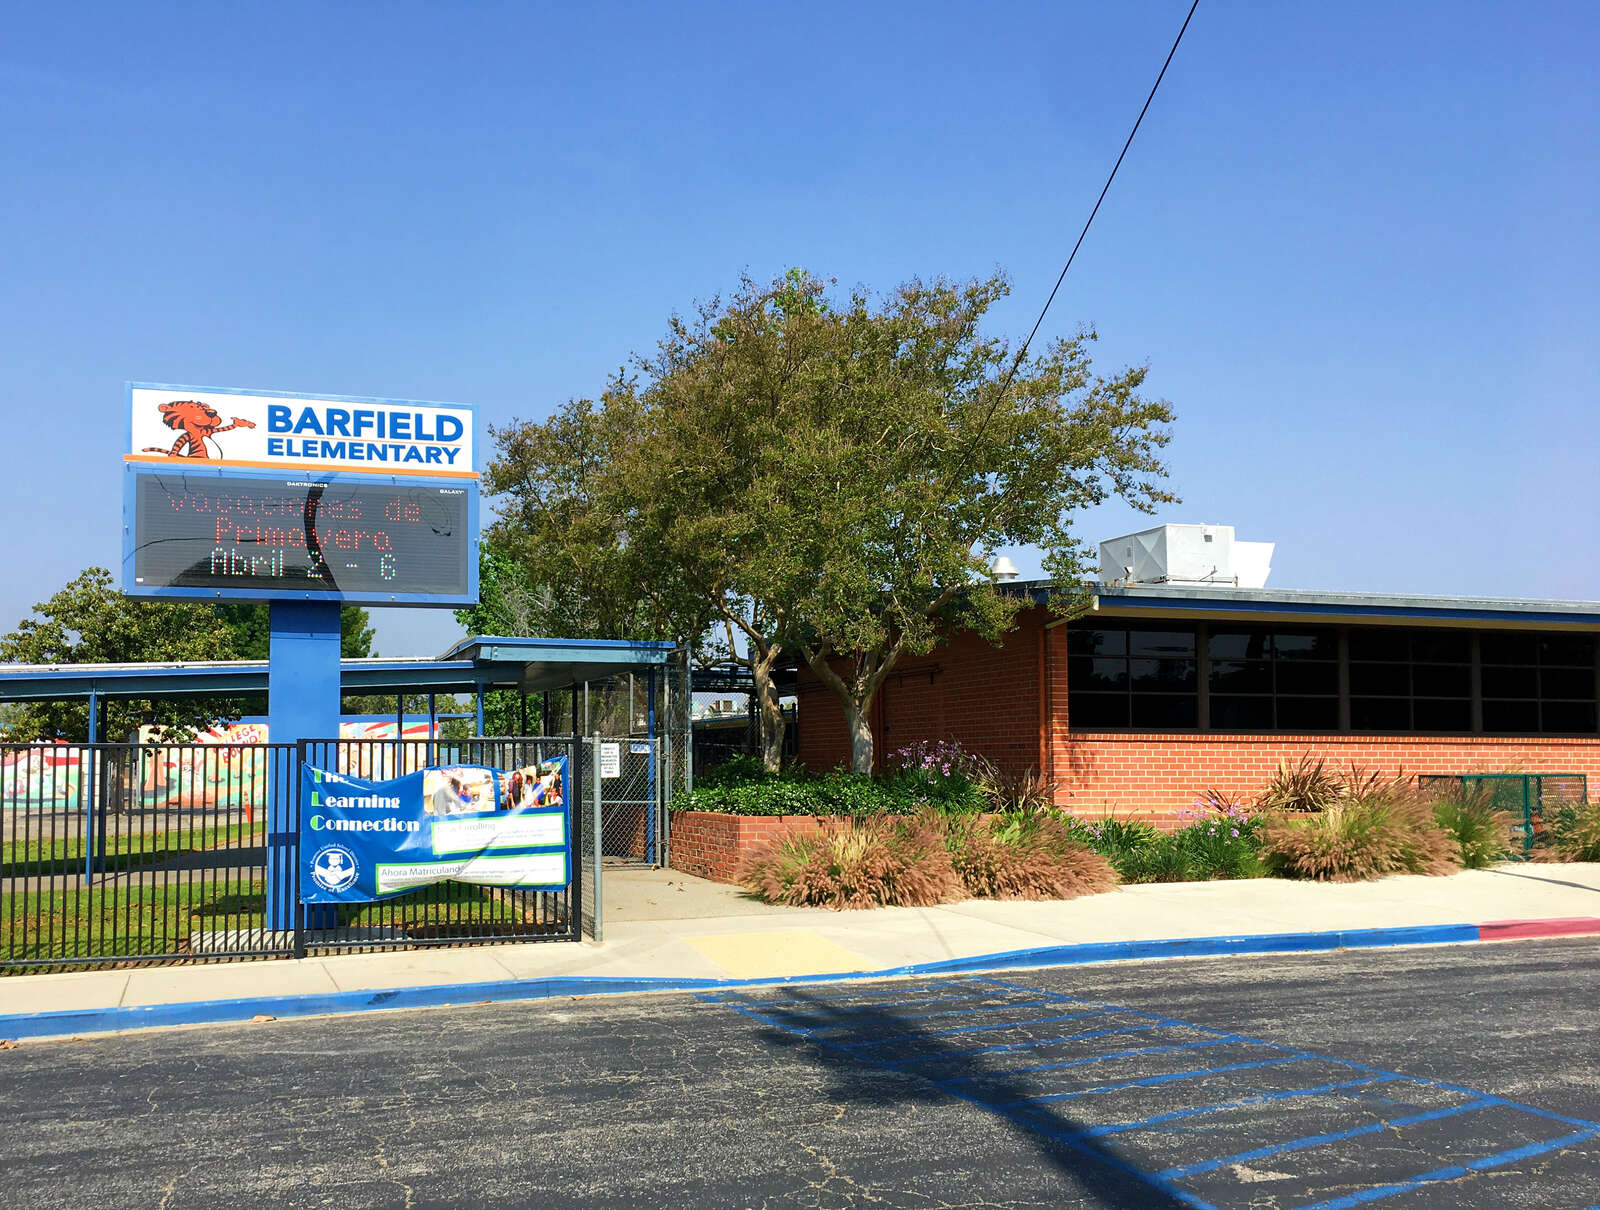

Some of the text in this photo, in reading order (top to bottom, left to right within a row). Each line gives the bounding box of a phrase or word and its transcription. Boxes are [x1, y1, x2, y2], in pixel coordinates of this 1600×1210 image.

[267, 404, 464, 442] BARFIELD
[267, 437, 462, 465] ELEMENTARY
[384, 496, 421, 521] de
[215, 515, 393, 551] Primavera
[210, 546, 286, 577] Abril
[306, 550, 324, 578] 2
[380, 553, 397, 581] 6
[311, 791, 401, 809] Learning
[310, 815, 420, 831] Connection
[381, 868, 408, 877] Ahora
